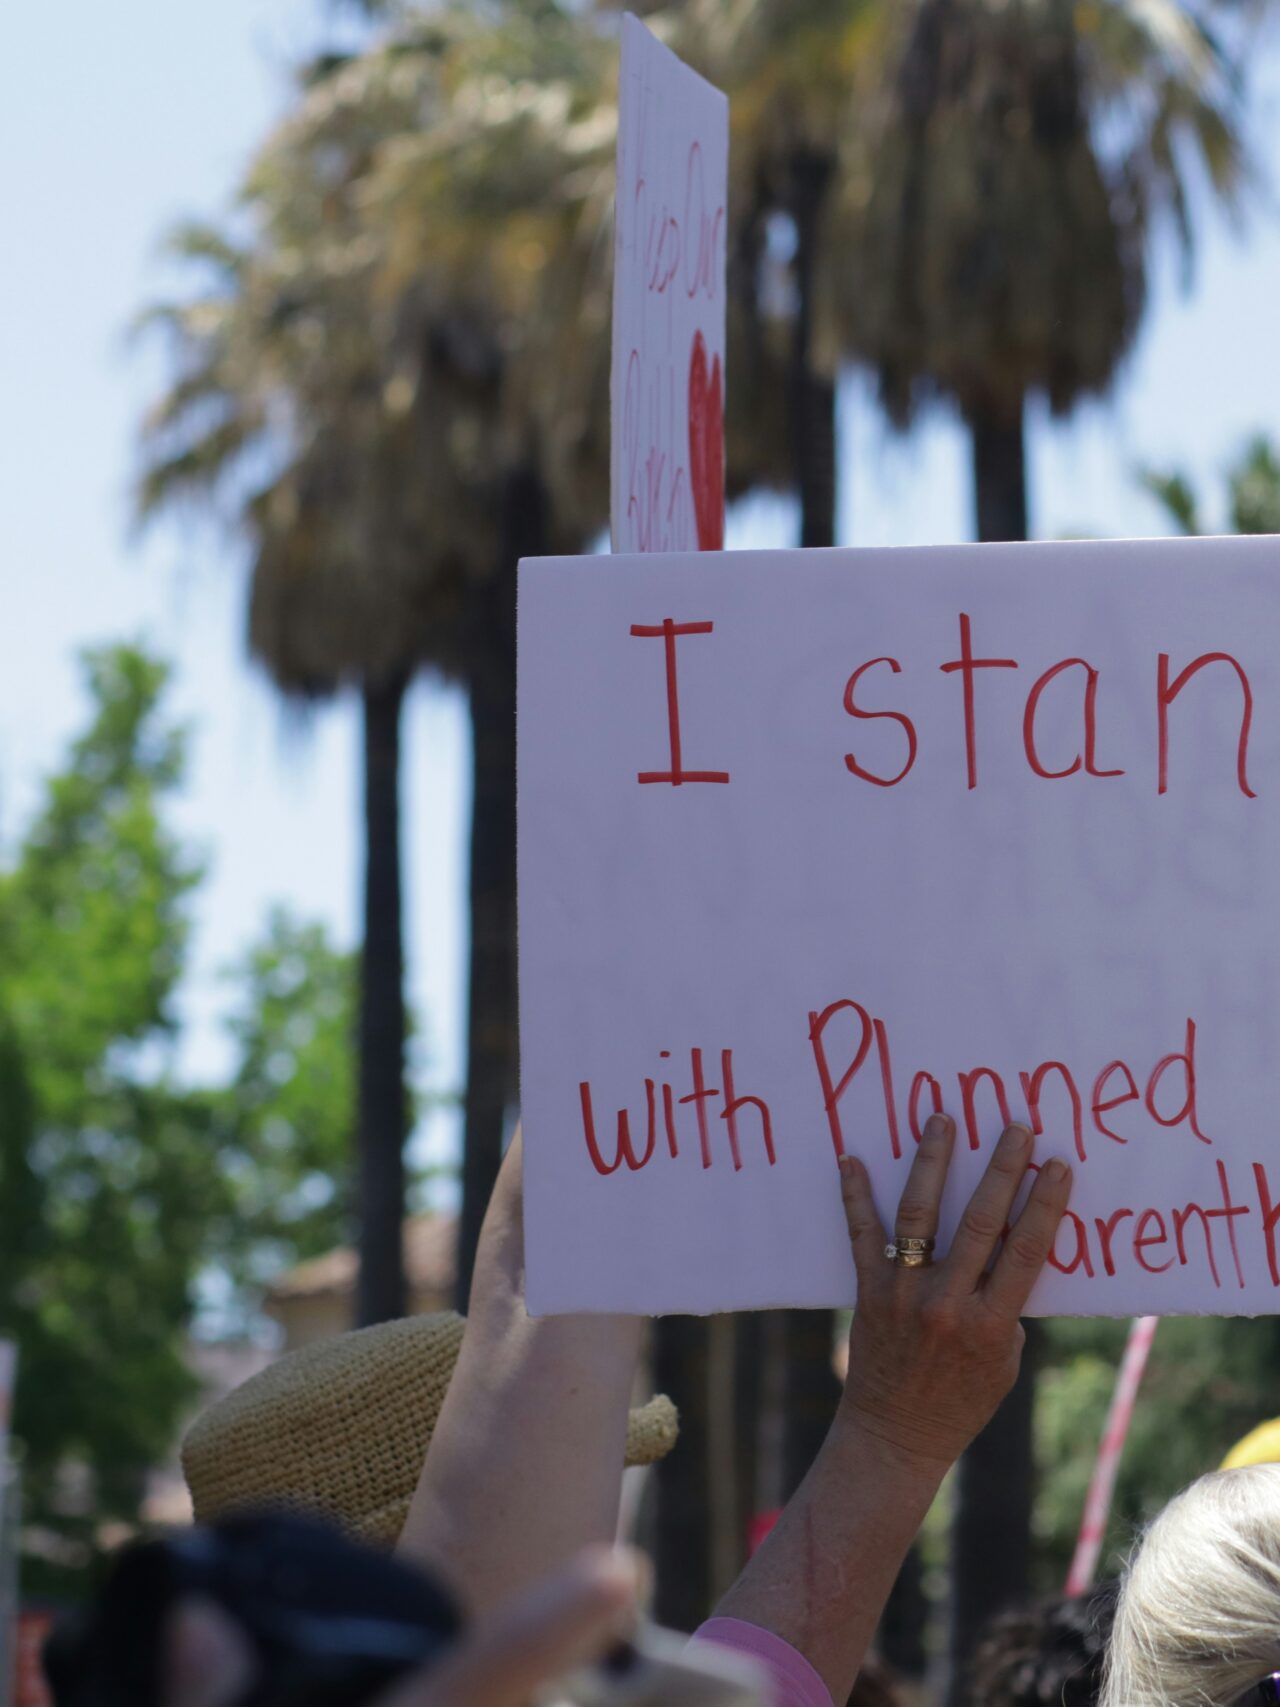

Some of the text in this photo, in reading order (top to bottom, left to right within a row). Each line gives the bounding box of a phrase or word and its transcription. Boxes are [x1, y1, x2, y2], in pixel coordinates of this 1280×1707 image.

[631, 619, 729, 786] I
[580, 1049, 775, 1175] with
[809, 1000, 1212, 1162] Planned
